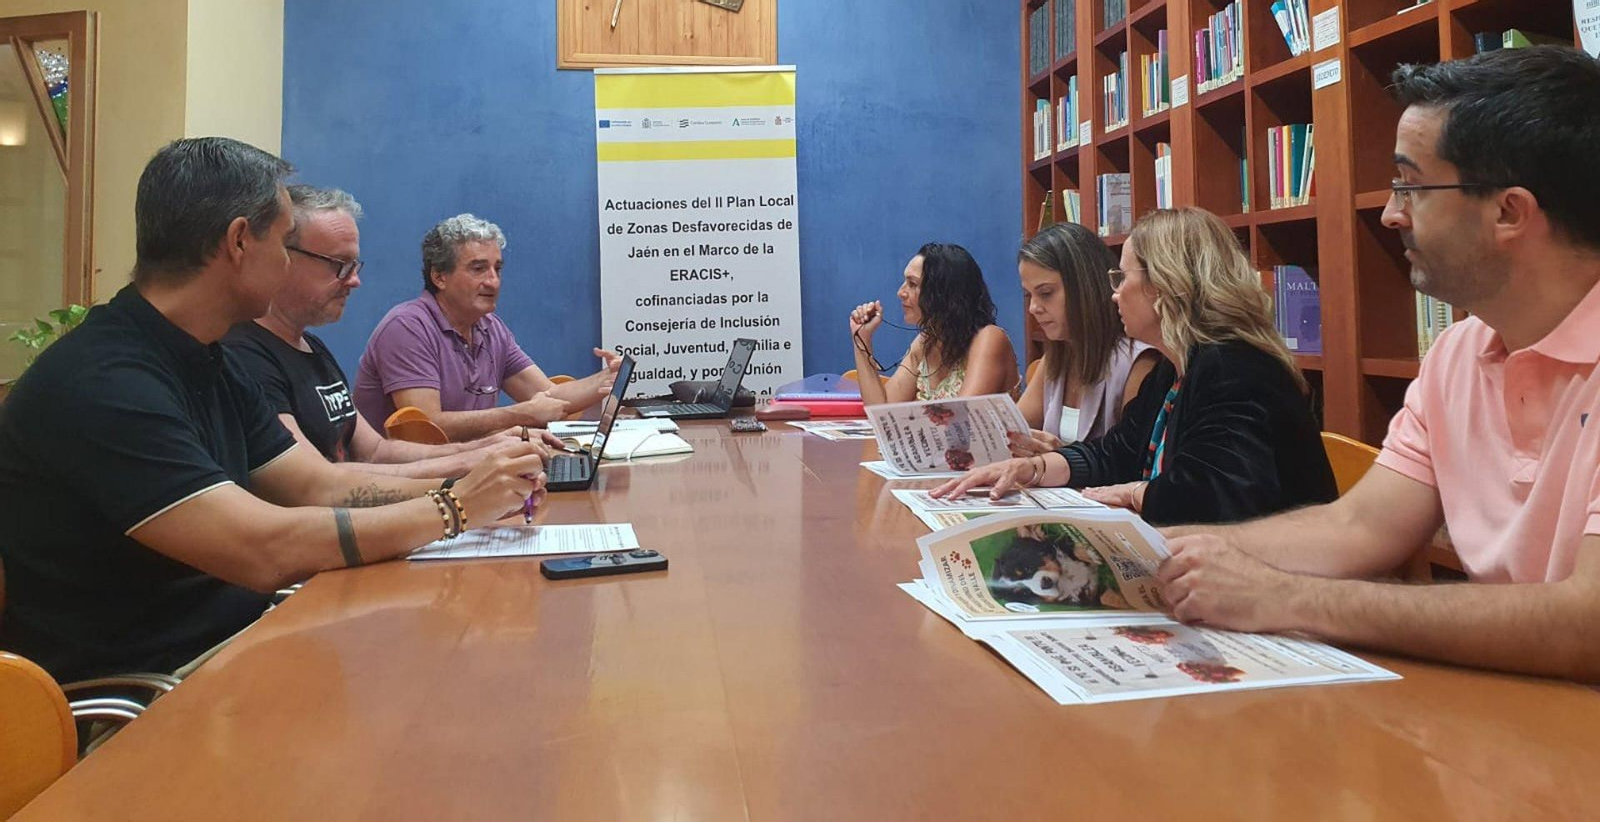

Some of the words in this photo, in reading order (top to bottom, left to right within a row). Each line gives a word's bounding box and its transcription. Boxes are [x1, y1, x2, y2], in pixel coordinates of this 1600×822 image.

[604, 198, 688, 211] Actuaciones
[691, 196, 711, 209] del
[715, 196, 723, 208] II
[726, 196, 755, 208] Plan
[759, 194, 794, 207] Local
[607, 223, 624, 235] de
[626, 222, 668, 235] Zonas
[672, 219, 773, 233] Desfavorecidas
[777, 218, 793, 230] de
[627, 245, 660, 259] Jaén
[663, 247, 680, 257] en
[683, 244, 695, 257] el
[699, 244, 740, 256] Marco
[743, 242, 759, 255] de
[762, 242, 774, 255] la
[670, 268, 734, 282] ERACIS+,
[635, 292, 728, 307] cofinanciadas
[731, 293, 754, 307] por
[757, 291, 769, 303] la
[625, 317, 697, 334] Consejería
[700, 317, 717, 329] de
[720, 314, 780, 329] Inclusión
[614, 344, 660, 358] Social,
[663, 341, 729, 354] Juventud,
[783, 340, 792, 350] e
[629, 367, 687, 383] gualdad,
[690, 369, 698, 380] y
[702, 367, 724, 379] por
[744, 361, 782, 375] Unión
